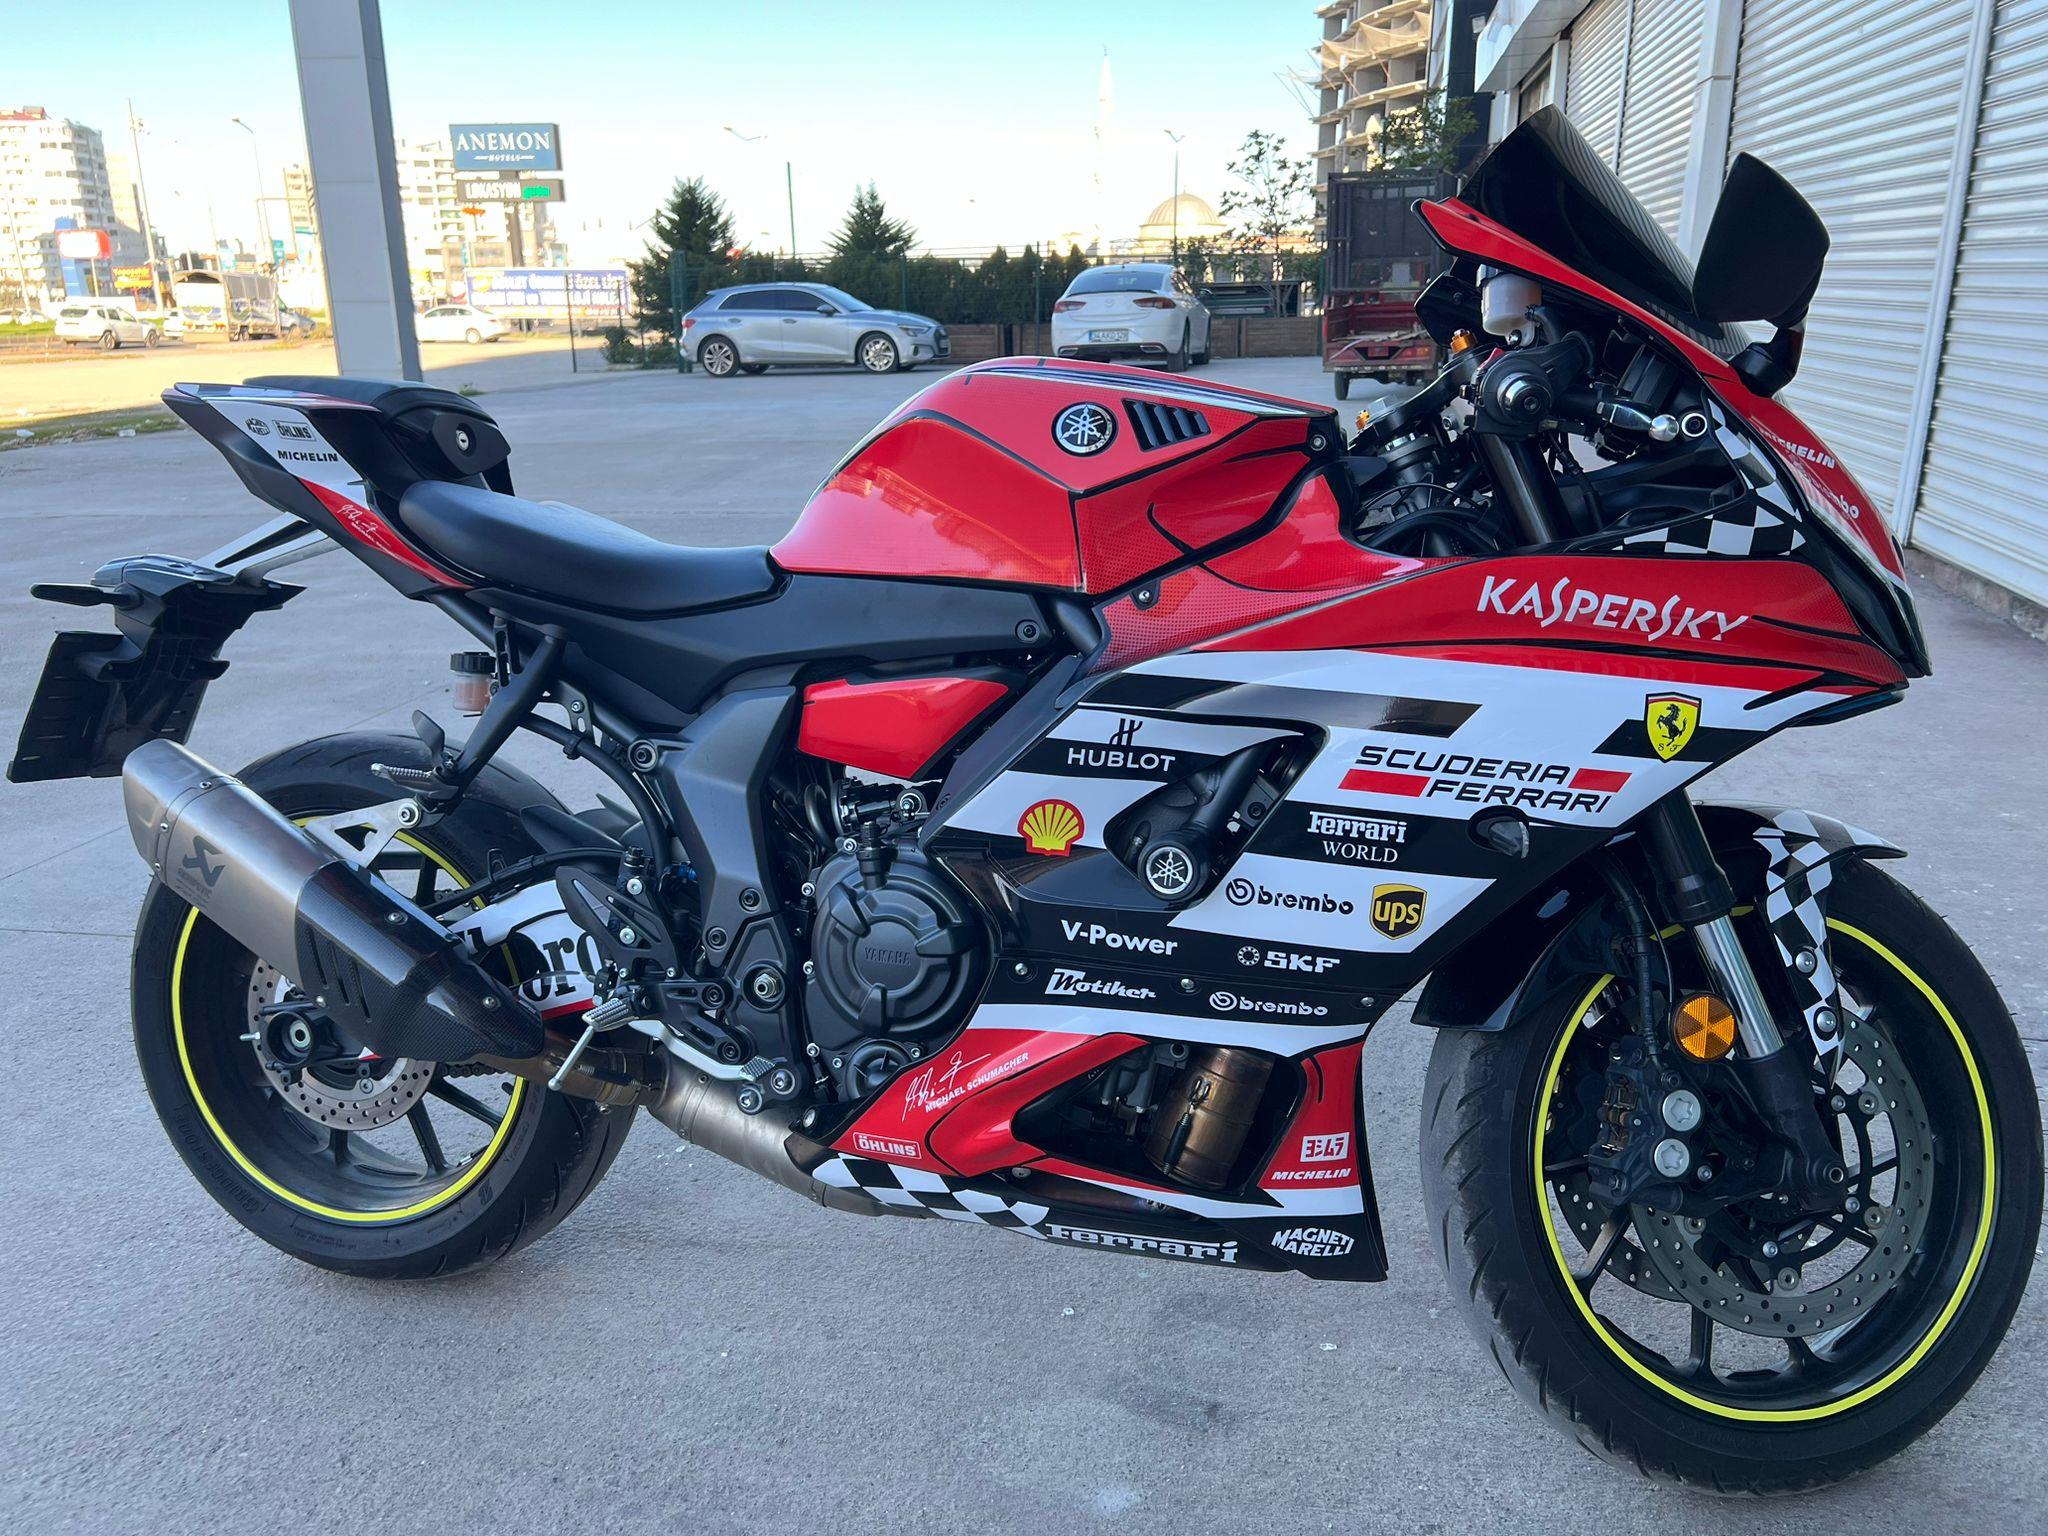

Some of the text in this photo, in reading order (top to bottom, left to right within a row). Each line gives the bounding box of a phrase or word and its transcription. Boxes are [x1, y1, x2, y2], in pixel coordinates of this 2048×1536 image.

[456, 132, 550, 151] ANEMON
[277, 450, 338, 462] MICHELIN
[1477, 575, 1748, 642] KASPERSKY
[1067, 748, 1175, 772] HUBLOT
[1355, 745, 1571, 785] SCUDERIA
[1426, 780, 1612, 813] FERRARI
[1307, 810, 1407, 843] Ferrari
[1322, 841, 1398, 864] WORLD
[1257, 885, 1354, 916] brembo
[1374, 901, 1421, 932] ups
[1061, 920, 1178, 956] V-Power
[864, 946, 912, 967] YAMAHA
[1264, 950, 1341, 973] SKF
[1238, 996, 1329, 1017] brembo
[925, 1089, 966, 1114] MICHAEL
[967, 1052, 1030, 1091] SCHUMACHER
[858, 1135, 918, 1157] ÖHLINS
[1271, 1168, 1352, 1182] MICHELIN
[1045, 1223, 1239, 1264] Ferrari
